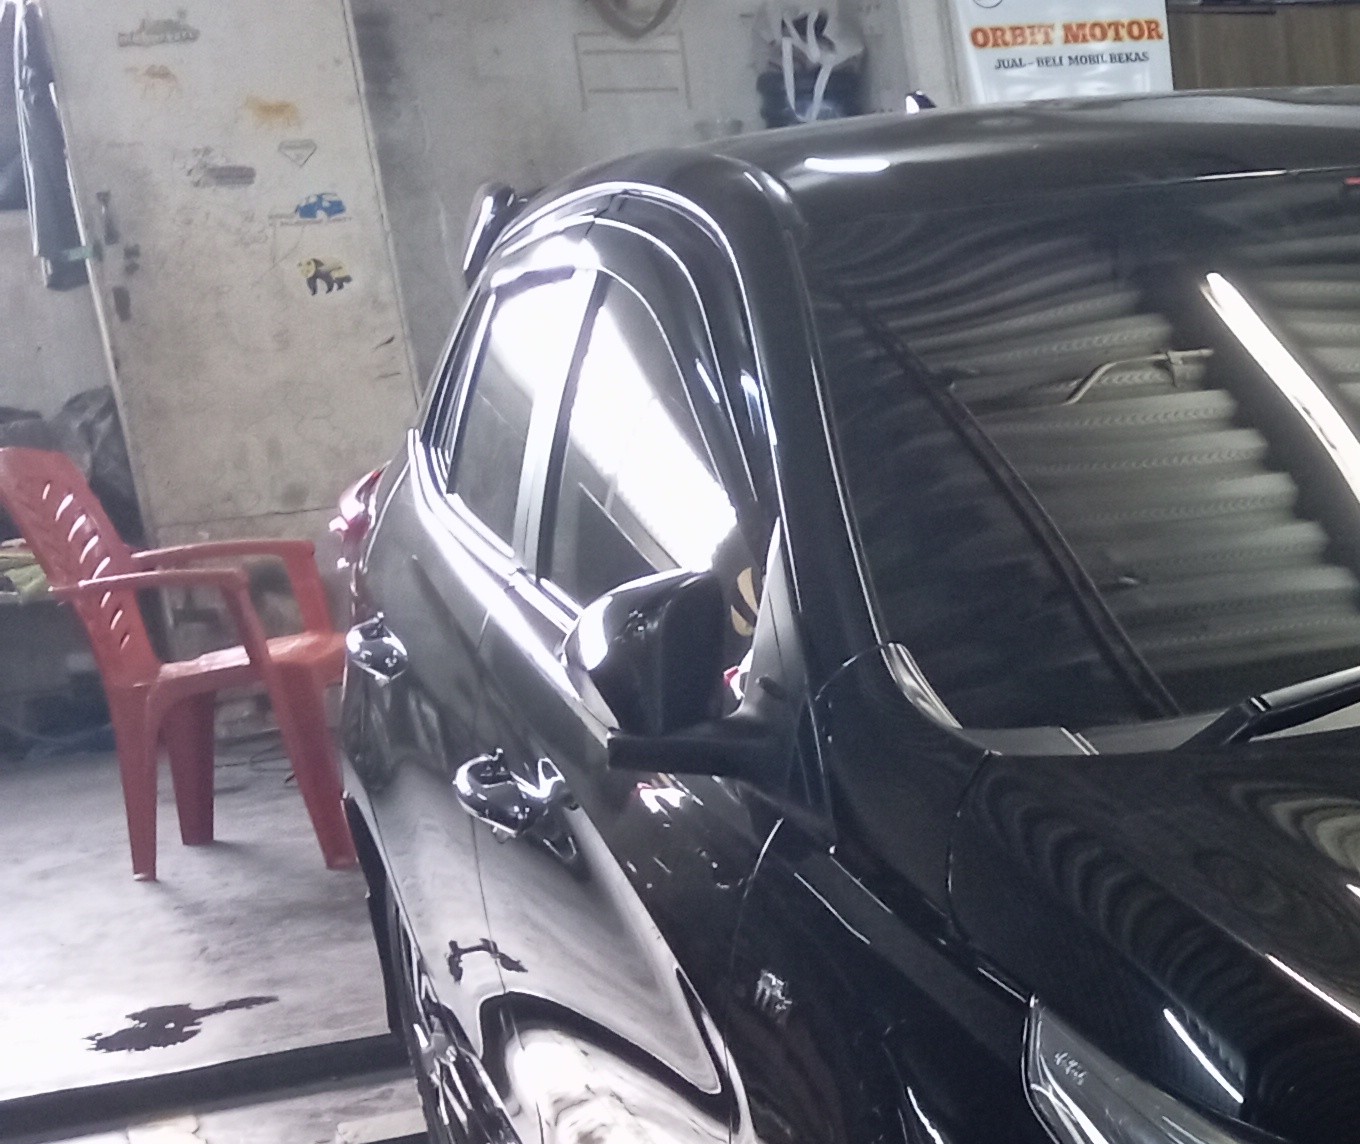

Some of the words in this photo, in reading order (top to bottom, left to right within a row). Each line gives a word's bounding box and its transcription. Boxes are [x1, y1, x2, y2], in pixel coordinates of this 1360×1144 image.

[970, 24, 1054, 48] ORBIT
[1062, 19, 1164, 45] MOTOR
[1067, 53, 1106, 67] MOBIL
[1109, 51, 1150, 64] BEKAS
